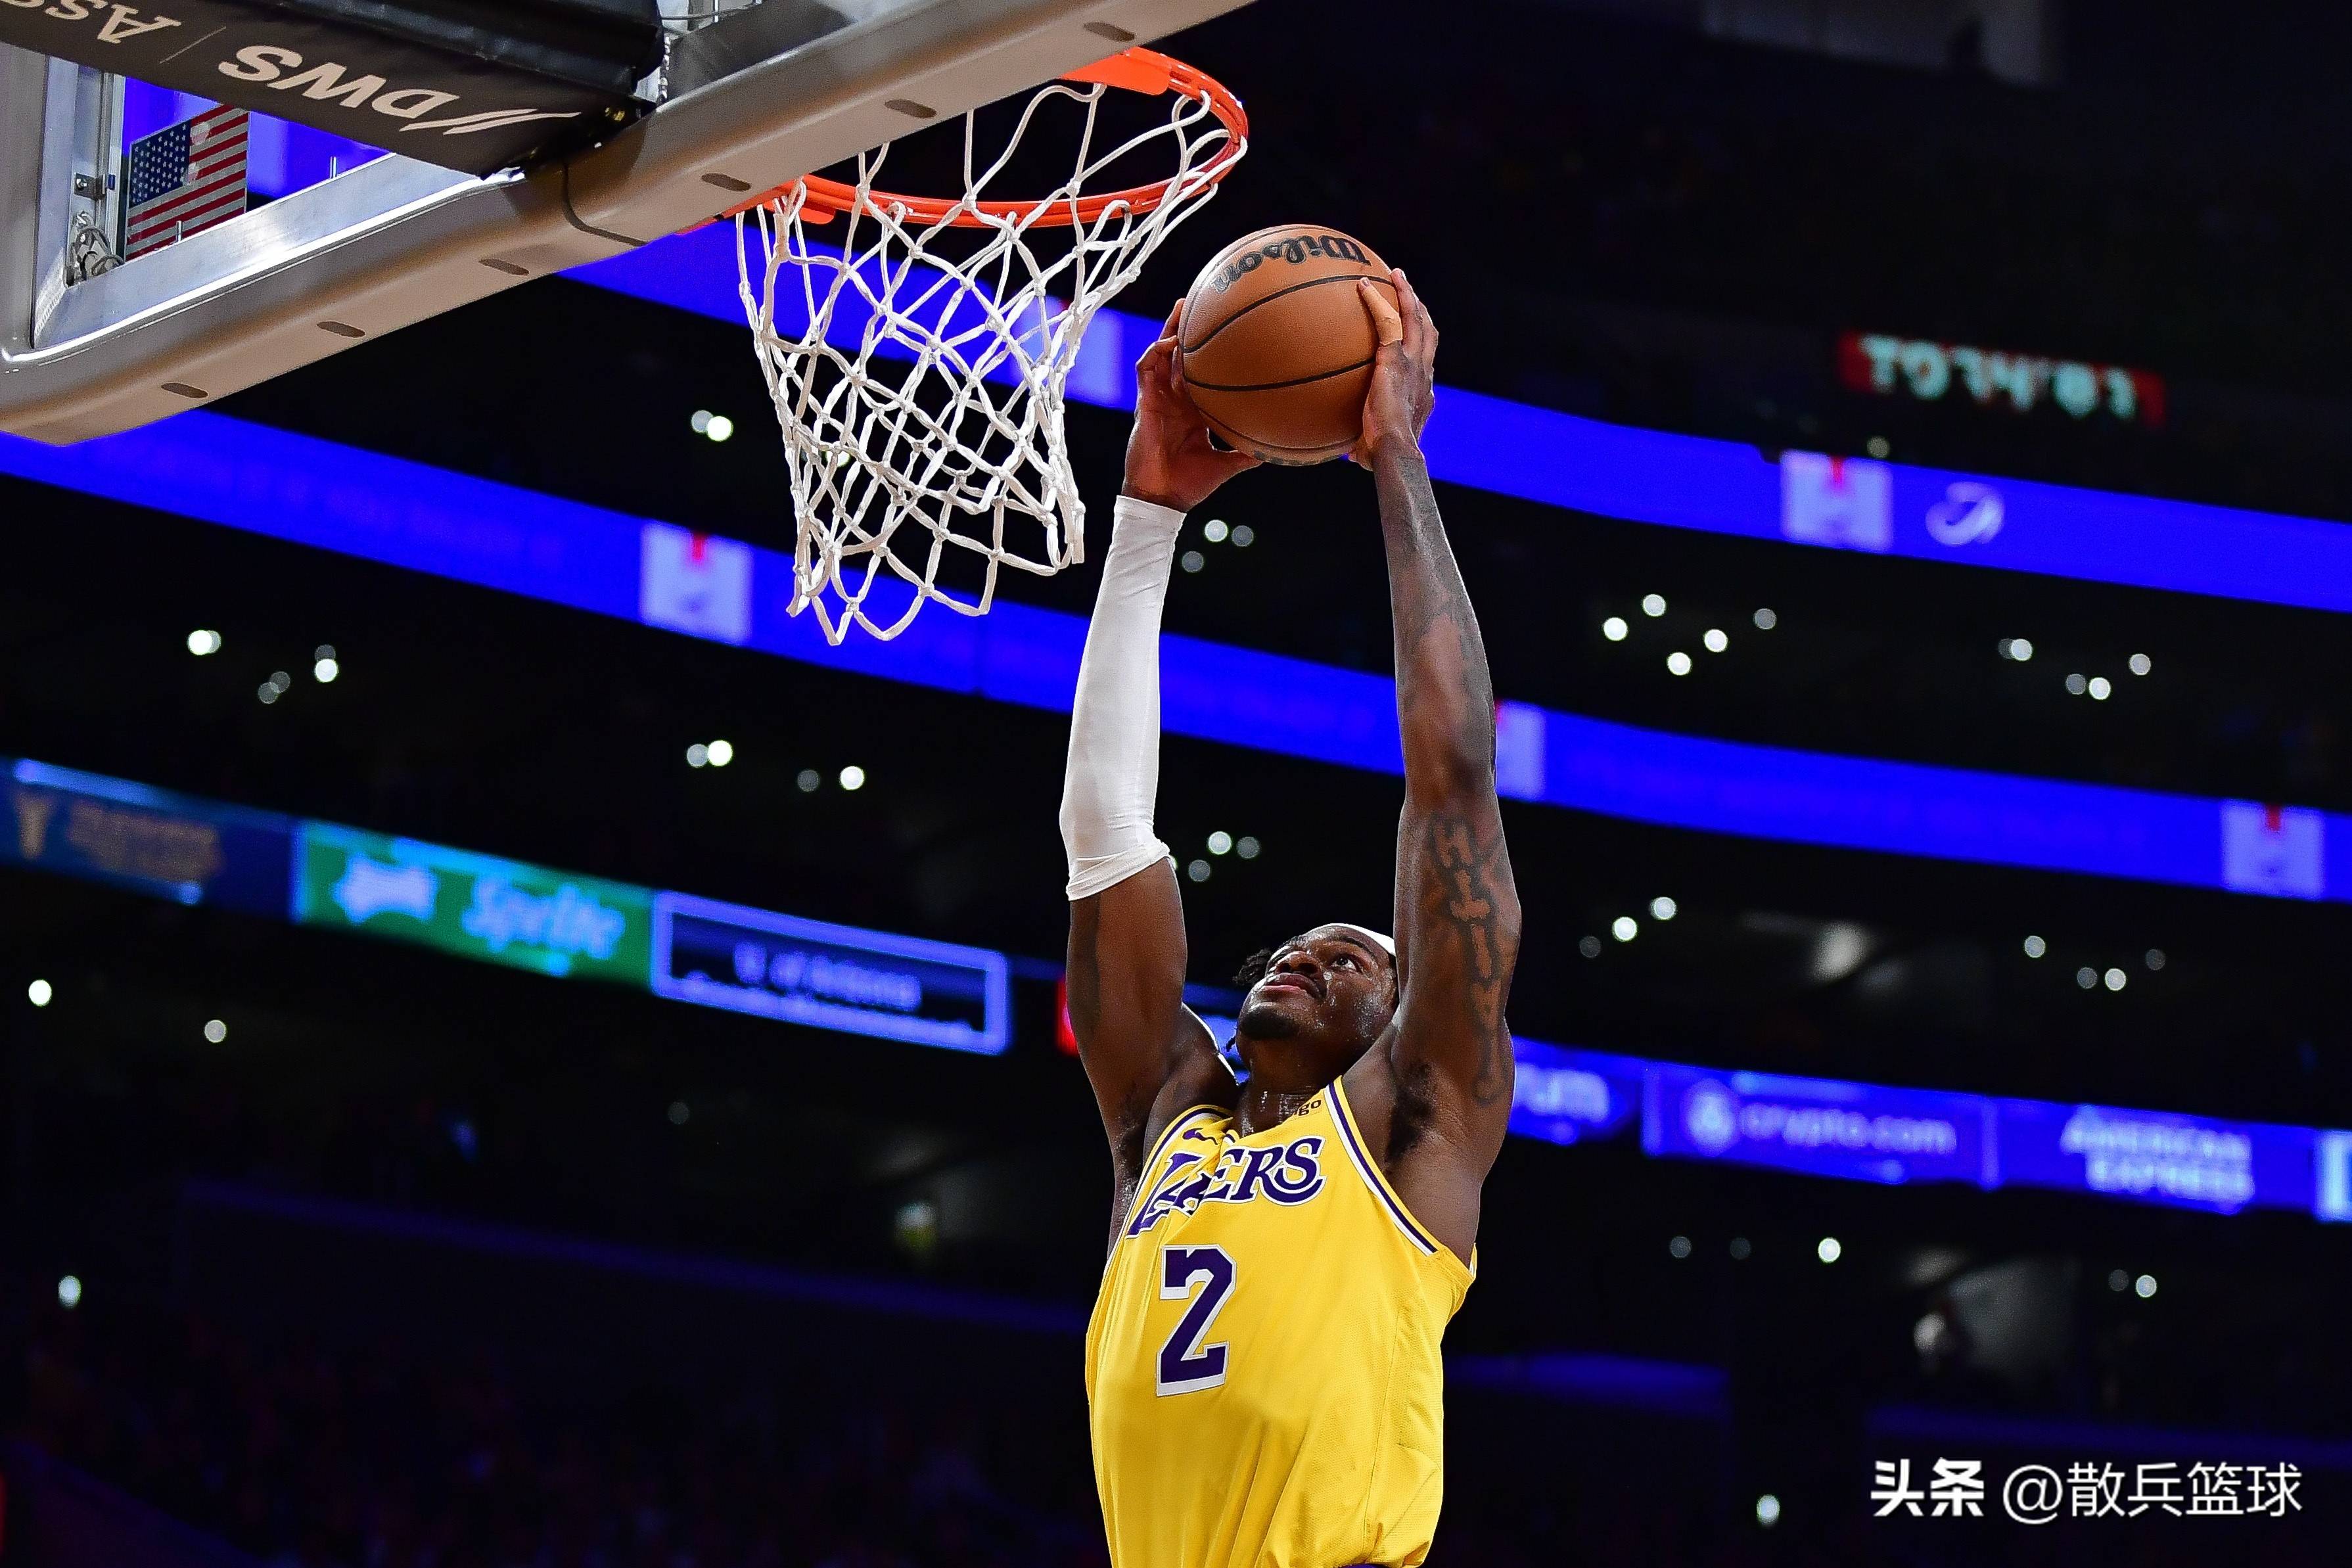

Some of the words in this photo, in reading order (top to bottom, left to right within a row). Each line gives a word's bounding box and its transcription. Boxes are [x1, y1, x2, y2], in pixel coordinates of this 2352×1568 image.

[218, 45, 461, 119] DWS
[1209, 235, 1372, 295] Wilson
[1738, 1101, 1958, 1155] crypto.com
[1157, 1243, 1237, 1398] 2
